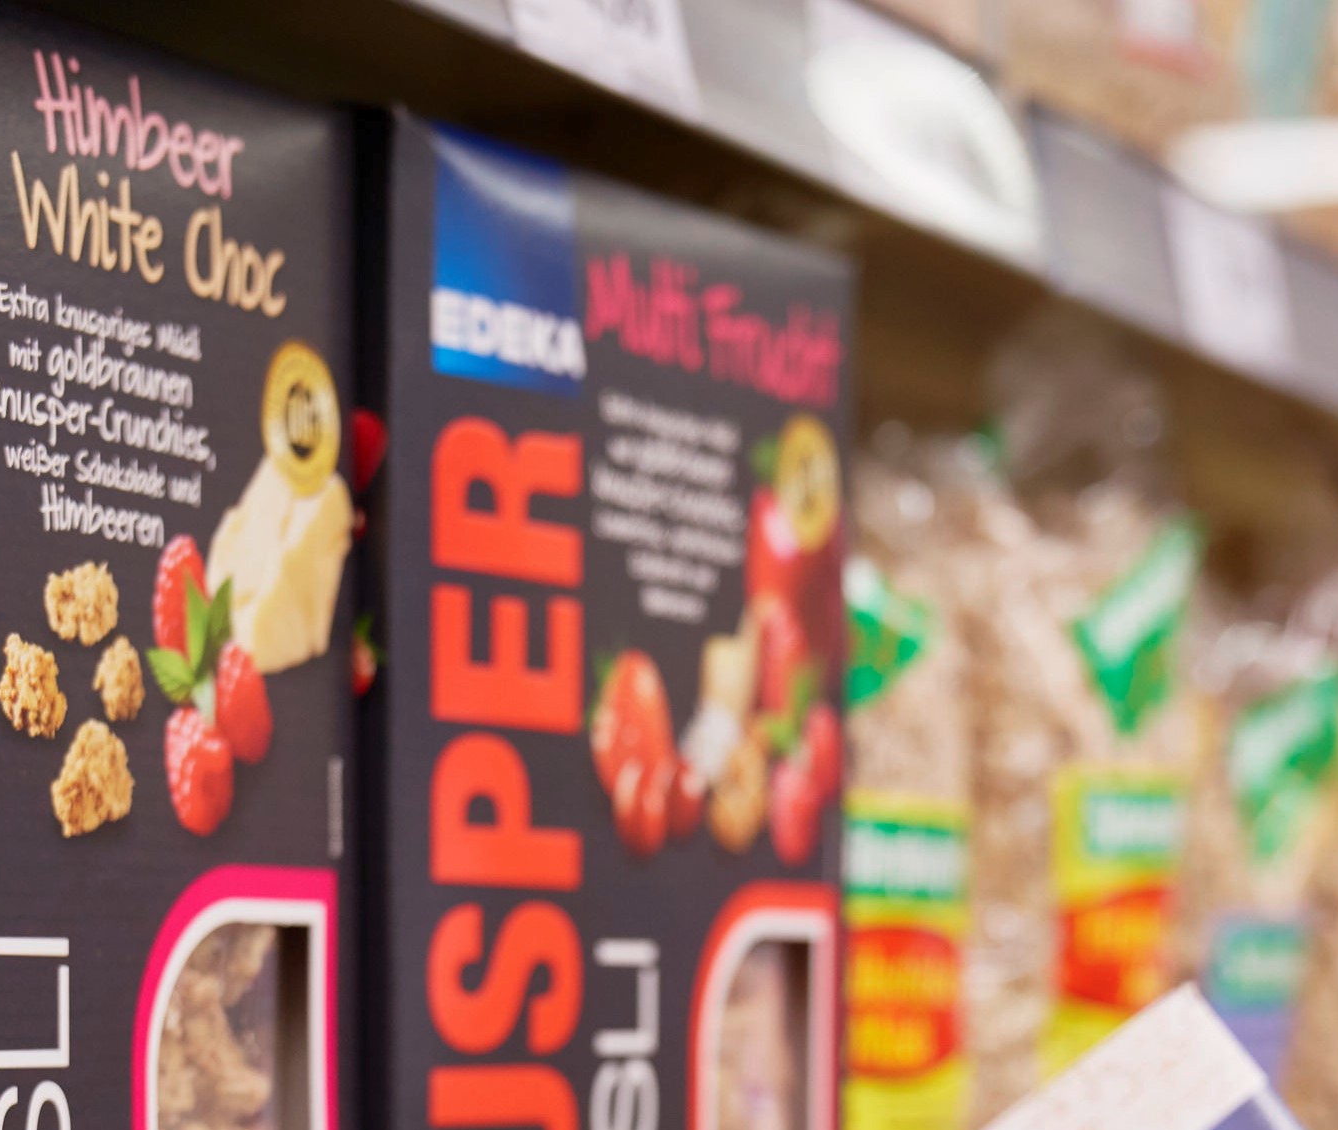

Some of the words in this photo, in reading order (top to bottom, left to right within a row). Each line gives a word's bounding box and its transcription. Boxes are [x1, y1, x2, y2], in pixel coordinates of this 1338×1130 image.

[34, 48, 245, 201] Himbeer
[11, 149, 165, 285] White
[183, 204, 287, 318] Choc
[55, 295, 153, 358] knuspriges
[429, 285, 587, 381] EDEKA
[8, 338, 42, 373] mit
[46, 335, 194, 409] goldbraunen
[4, 439, 70, 479] weißer
[74, 449, 166, 500] Schokolade
[167, 473, 203, 508] und
[39, 482, 165, 549] Himbeeren
